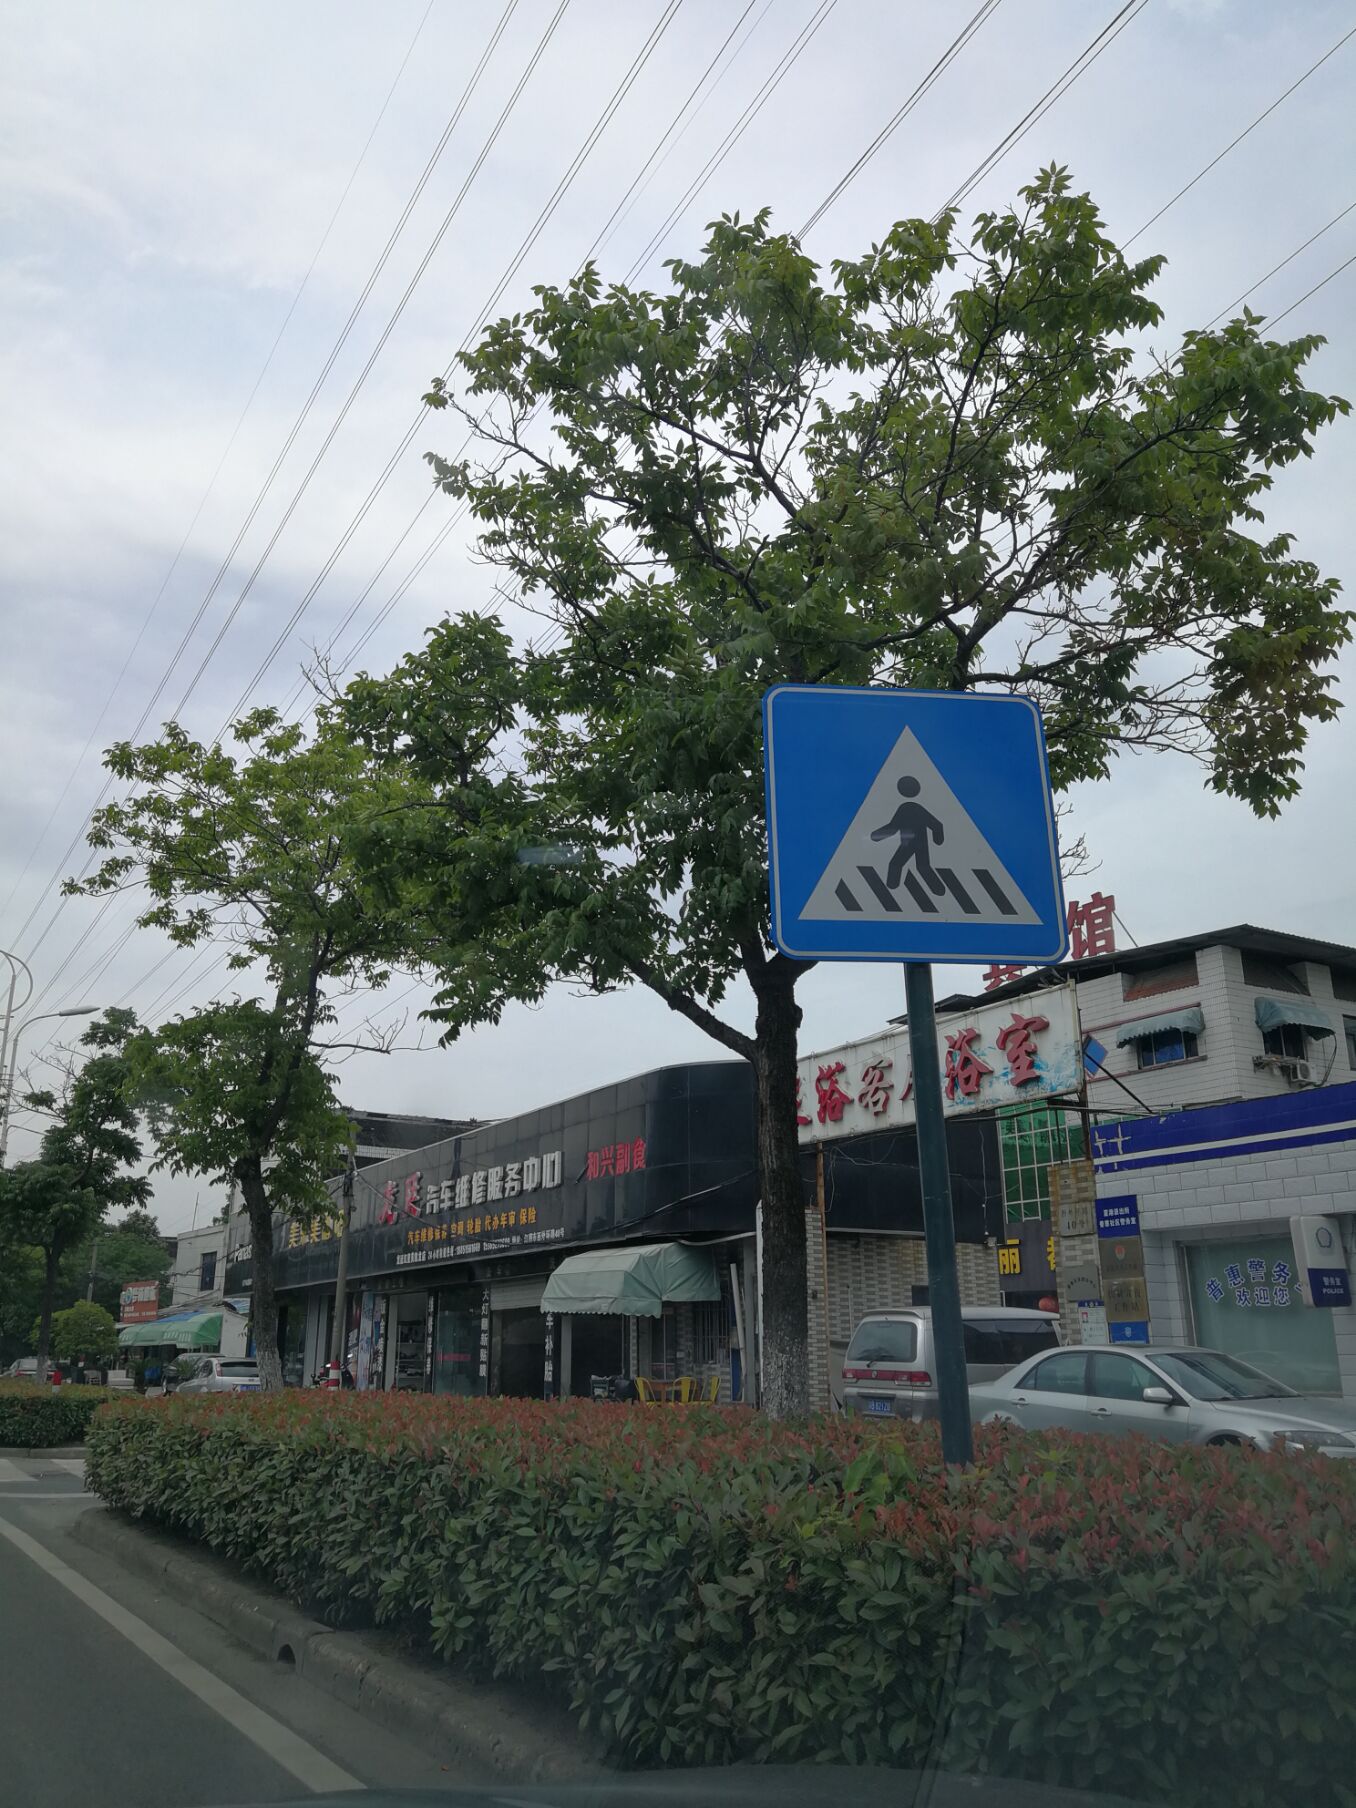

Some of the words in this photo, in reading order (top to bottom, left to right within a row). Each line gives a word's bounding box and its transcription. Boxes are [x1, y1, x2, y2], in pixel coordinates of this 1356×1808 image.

[797, 1013, 1050, 1126] 浴客浴室
[587, 1136, 646, 1180] 和兴副食
[425, 1151, 563, 1214] 汽车维修服务中心
[1205, 1257, 1304, 1303] 普惠警务
[1236, 1286, 1291, 1307] 欢迎您
